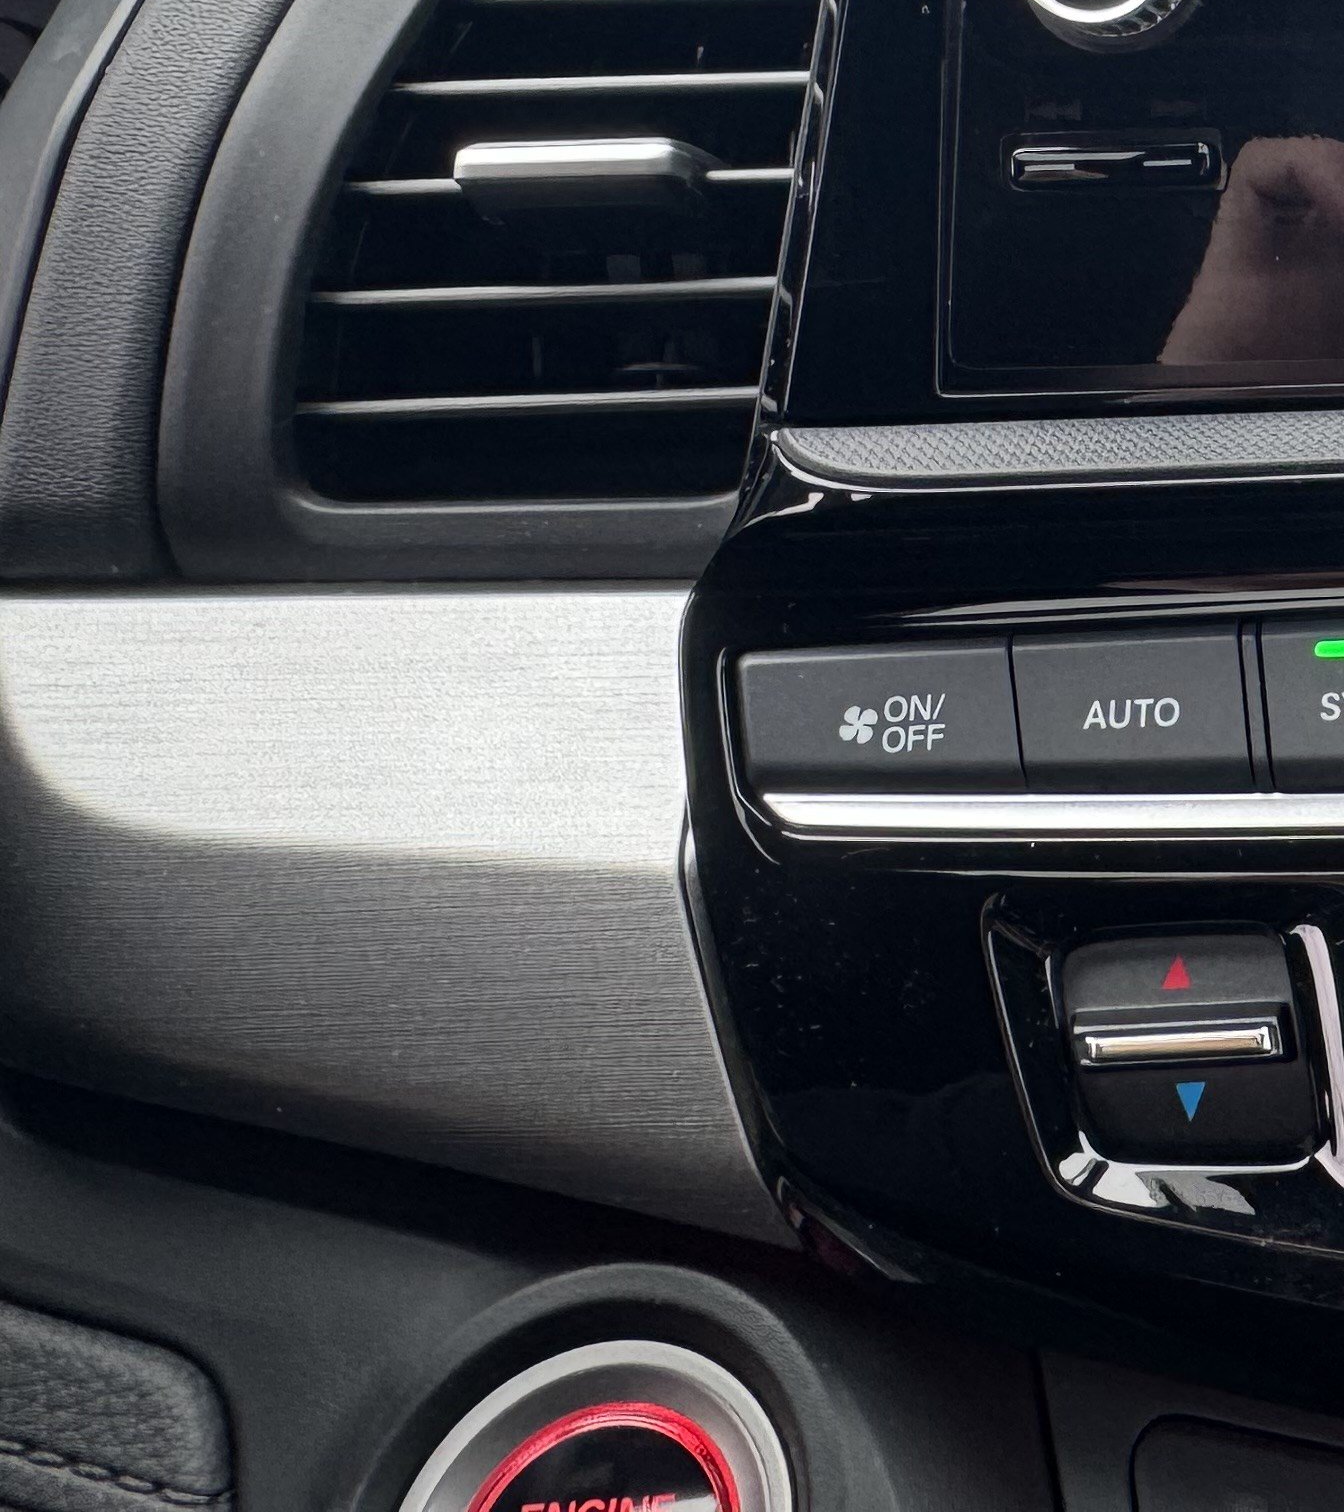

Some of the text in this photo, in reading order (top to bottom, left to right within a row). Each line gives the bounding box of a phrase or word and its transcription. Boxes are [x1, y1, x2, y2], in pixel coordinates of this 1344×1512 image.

[883, 693, 946, 723] ON/
[1082, 696, 1181, 730] AUTO
[881, 723, 946, 754] OFF
